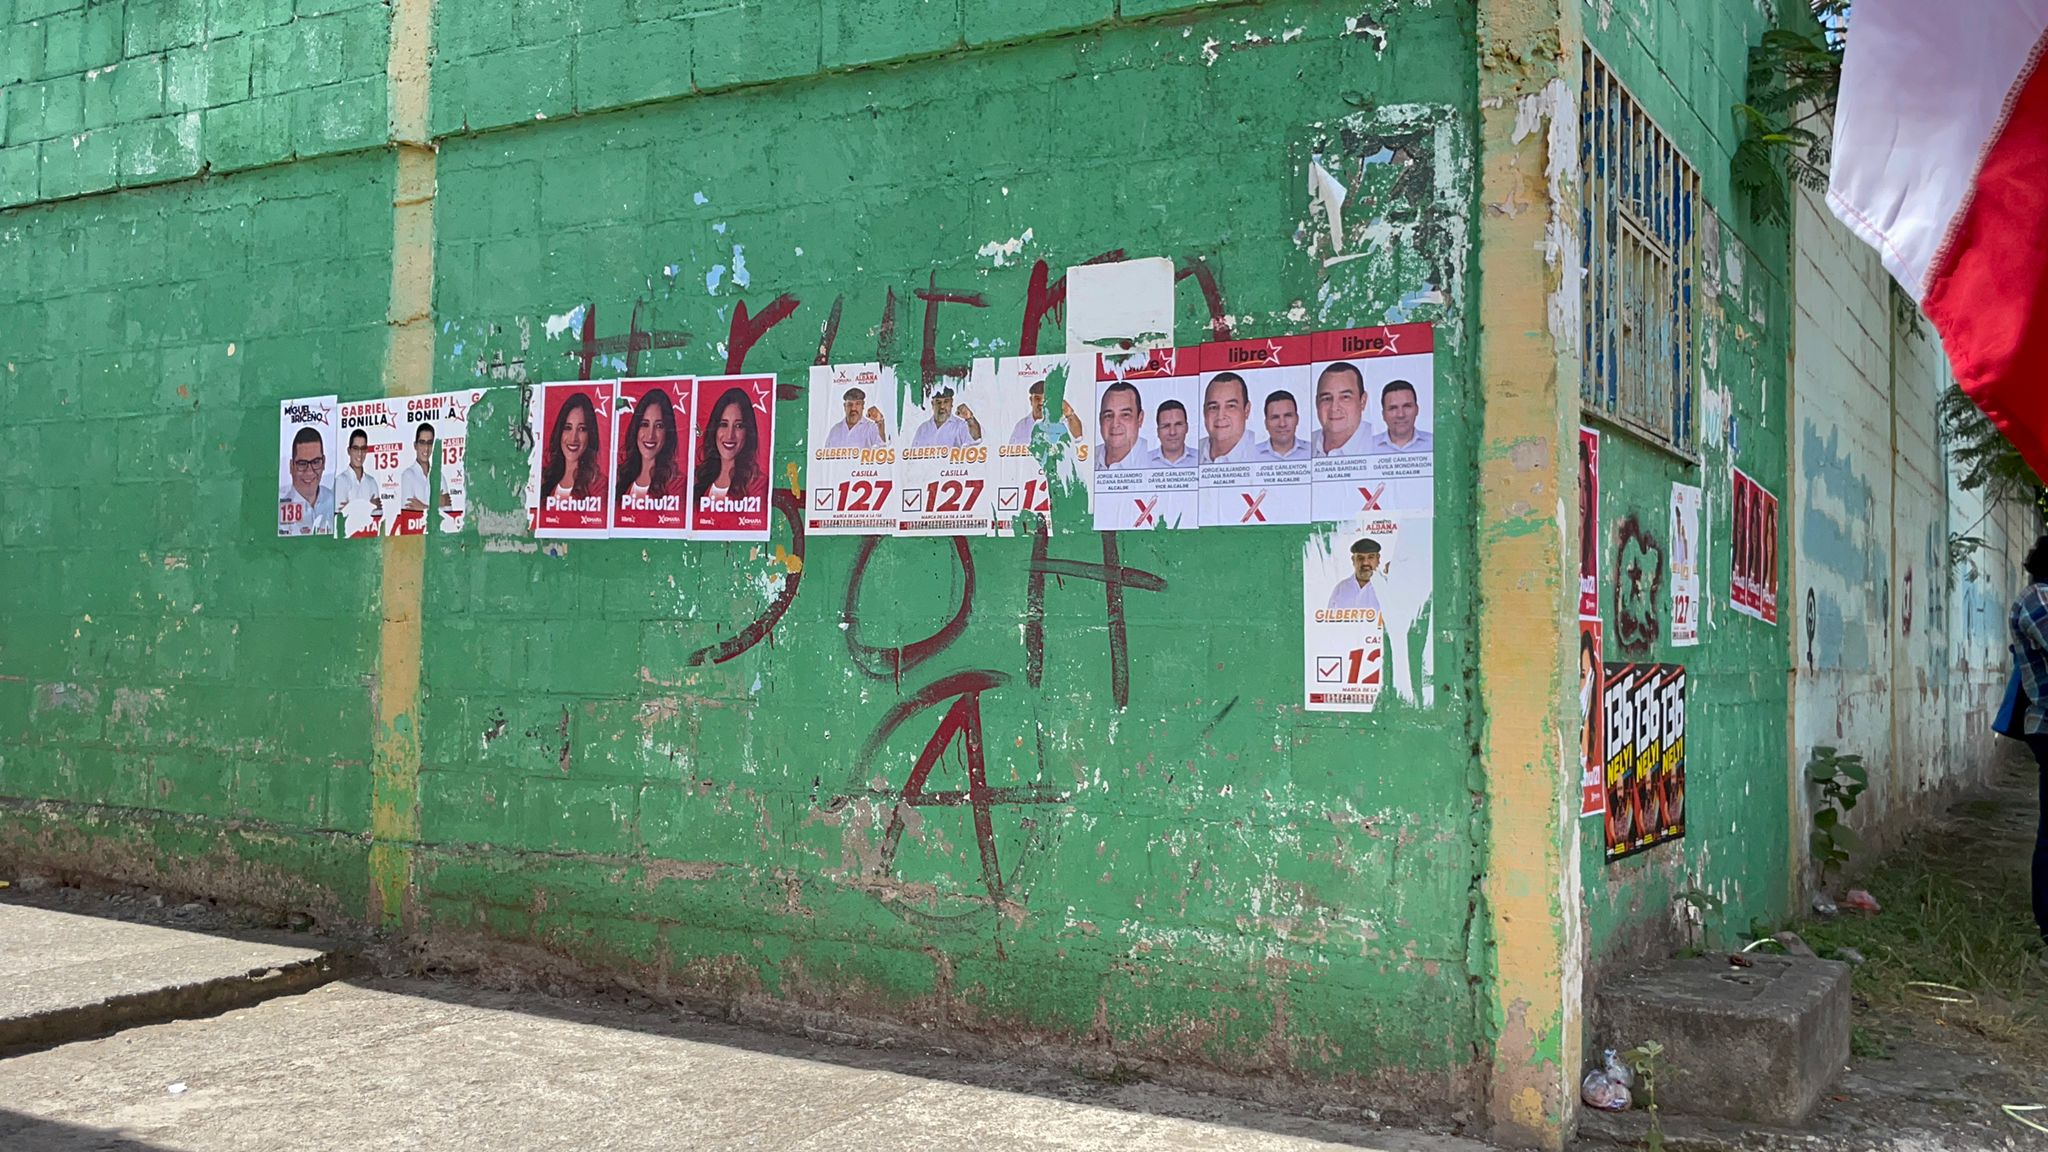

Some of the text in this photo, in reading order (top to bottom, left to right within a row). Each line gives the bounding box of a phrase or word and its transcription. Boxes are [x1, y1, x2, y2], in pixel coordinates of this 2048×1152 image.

[1342, 337, 1385, 353] libre
[1228, 346, 1269, 363] libre
[284, 405, 311, 416] MIGUEL
[341, 402, 388, 417] GABRIEL
[341, 413, 388, 429] BONILLA
[374, 442, 400, 452] CASILLA
[815, 447, 896, 465] GILBERTO RIOS
[902, 446, 987, 464] GILBERTO RIOS
[374, 452, 399, 471] 135
[940, 469, 969, 477] CASILLA
[546, 495, 602, 512] Pichu121
[621, 494, 680, 512] Pichu121
[700, 496, 761, 513] Pichu121
[837, 479, 893, 512] 127
[925, 479, 984, 513] 127
[281, 503, 302, 523] 138
[1315, 608, 1376, 623] GILBERTO
[1674, 594, 1690, 624] 127
[1347, 648, 1382, 684] 12
[1605, 673, 1634, 762] 136
[1635, 673, 1661, 758] 136
[1661, 673, 1685, 752] 136
